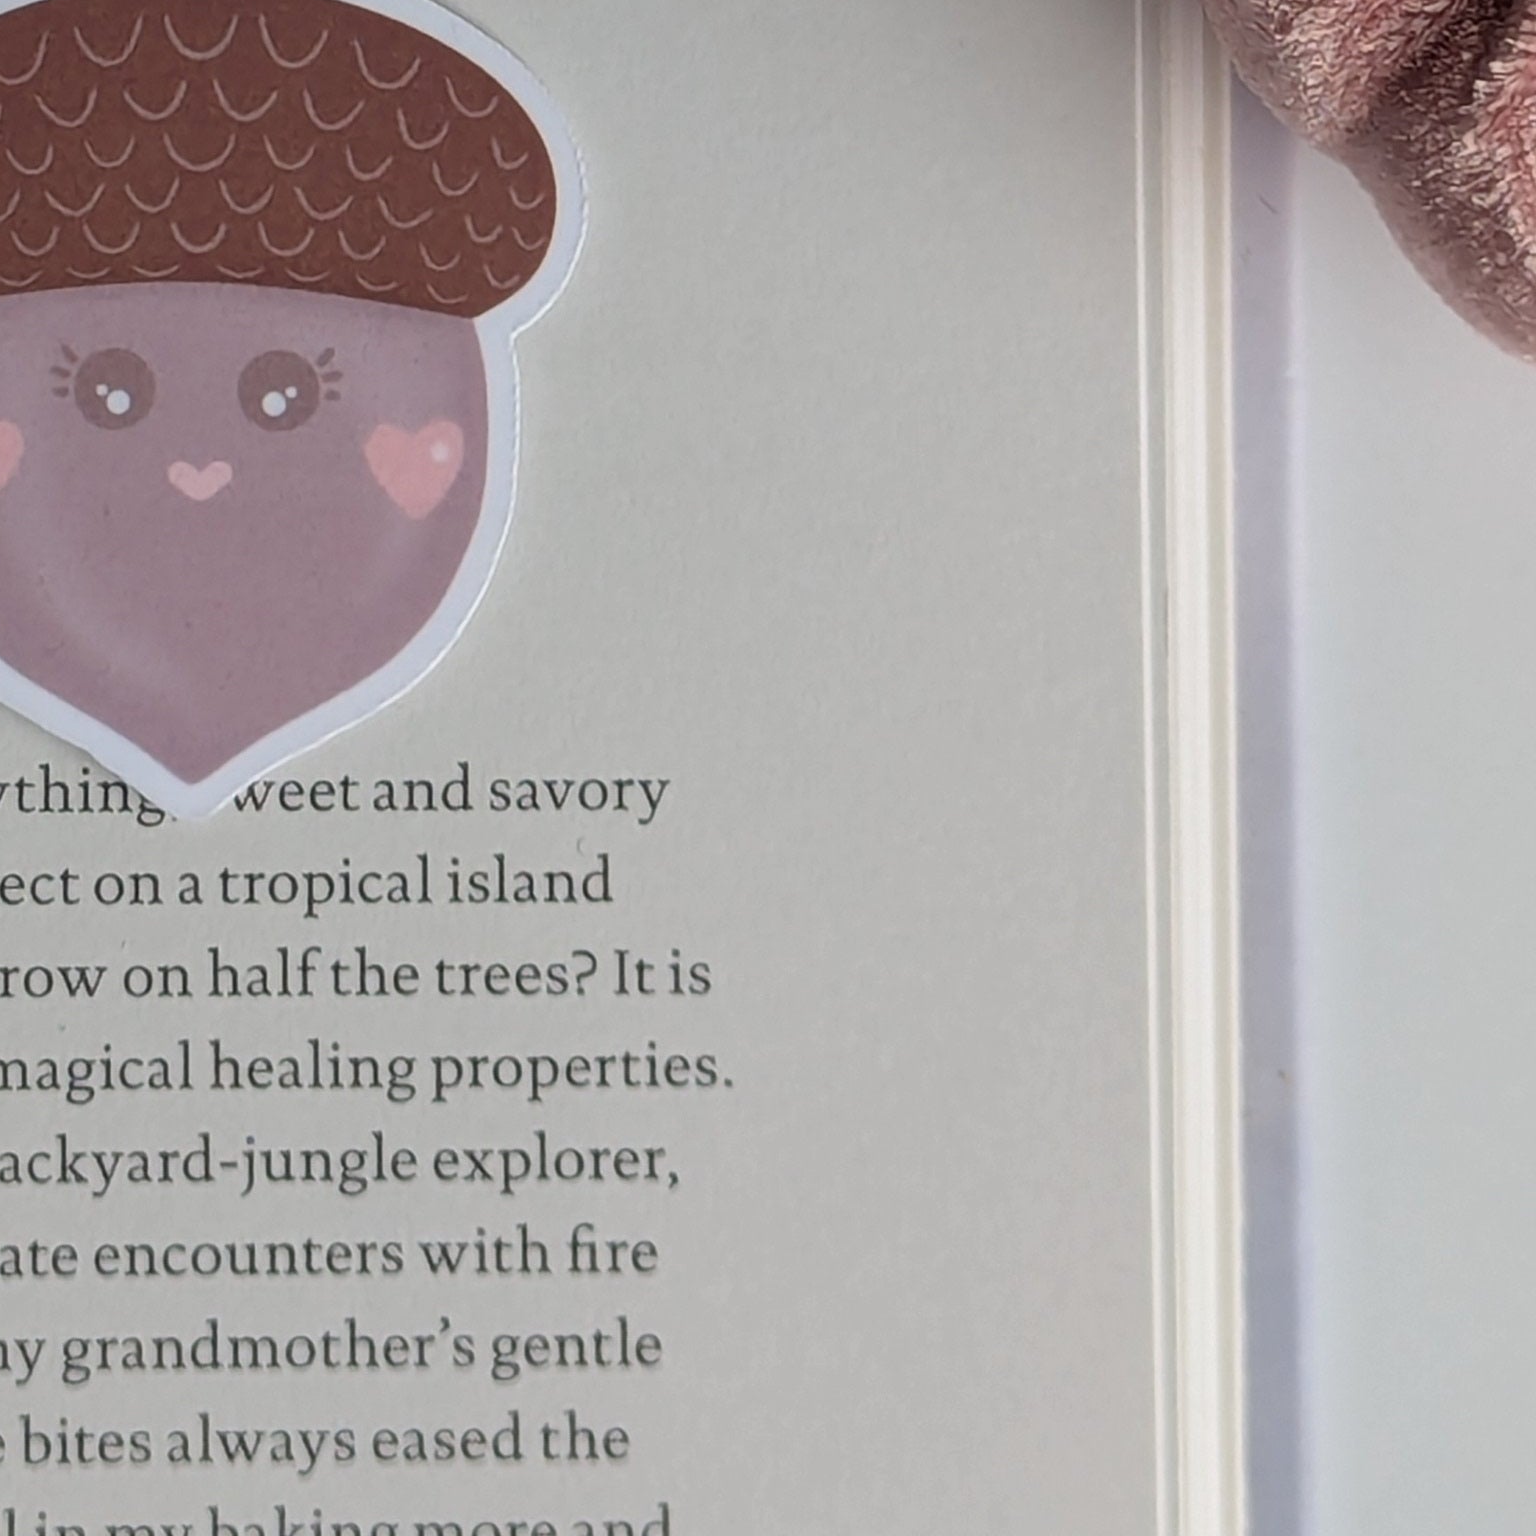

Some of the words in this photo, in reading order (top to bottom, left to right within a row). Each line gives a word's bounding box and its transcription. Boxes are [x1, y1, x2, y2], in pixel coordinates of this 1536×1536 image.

[233, 774, 360, 813] weet
[373, 761, 474, 812] and
[490, 778, 670, 826] savory
[94, 873, 163, 905] on
[179, 873, 203, 905] a
[219, 853, 432, 919] tropical
[447, 853, 613, 904] island
[123, 965, 193, 998] on
[208, 946, 322, 997] half
[330, 946, 419, 997] the
[435, 949, 597, 996] trees?
[614, 949, 655, 995] It
[669, 948, 711, 995] is
[209, 1038, 416, 1104] healing
[431, 1041, 733, 1103] properties.
[433, 1130, 679, 1196] explorer,
[94, 1238, 403, 1277] encounters
[418, 1223, 551, 1275] with
[568, 1222, 658, 1274] fire
[62, 1316, 475, 1386] grandmother’s
[491, 1316, 662, 1382] gentle
[19, 1414, 151, 1465] bites
[167, 1412, 356, 1477] always
[372, 1410, 523, 1462] eased
[541, 1409, 629, 1462] the
